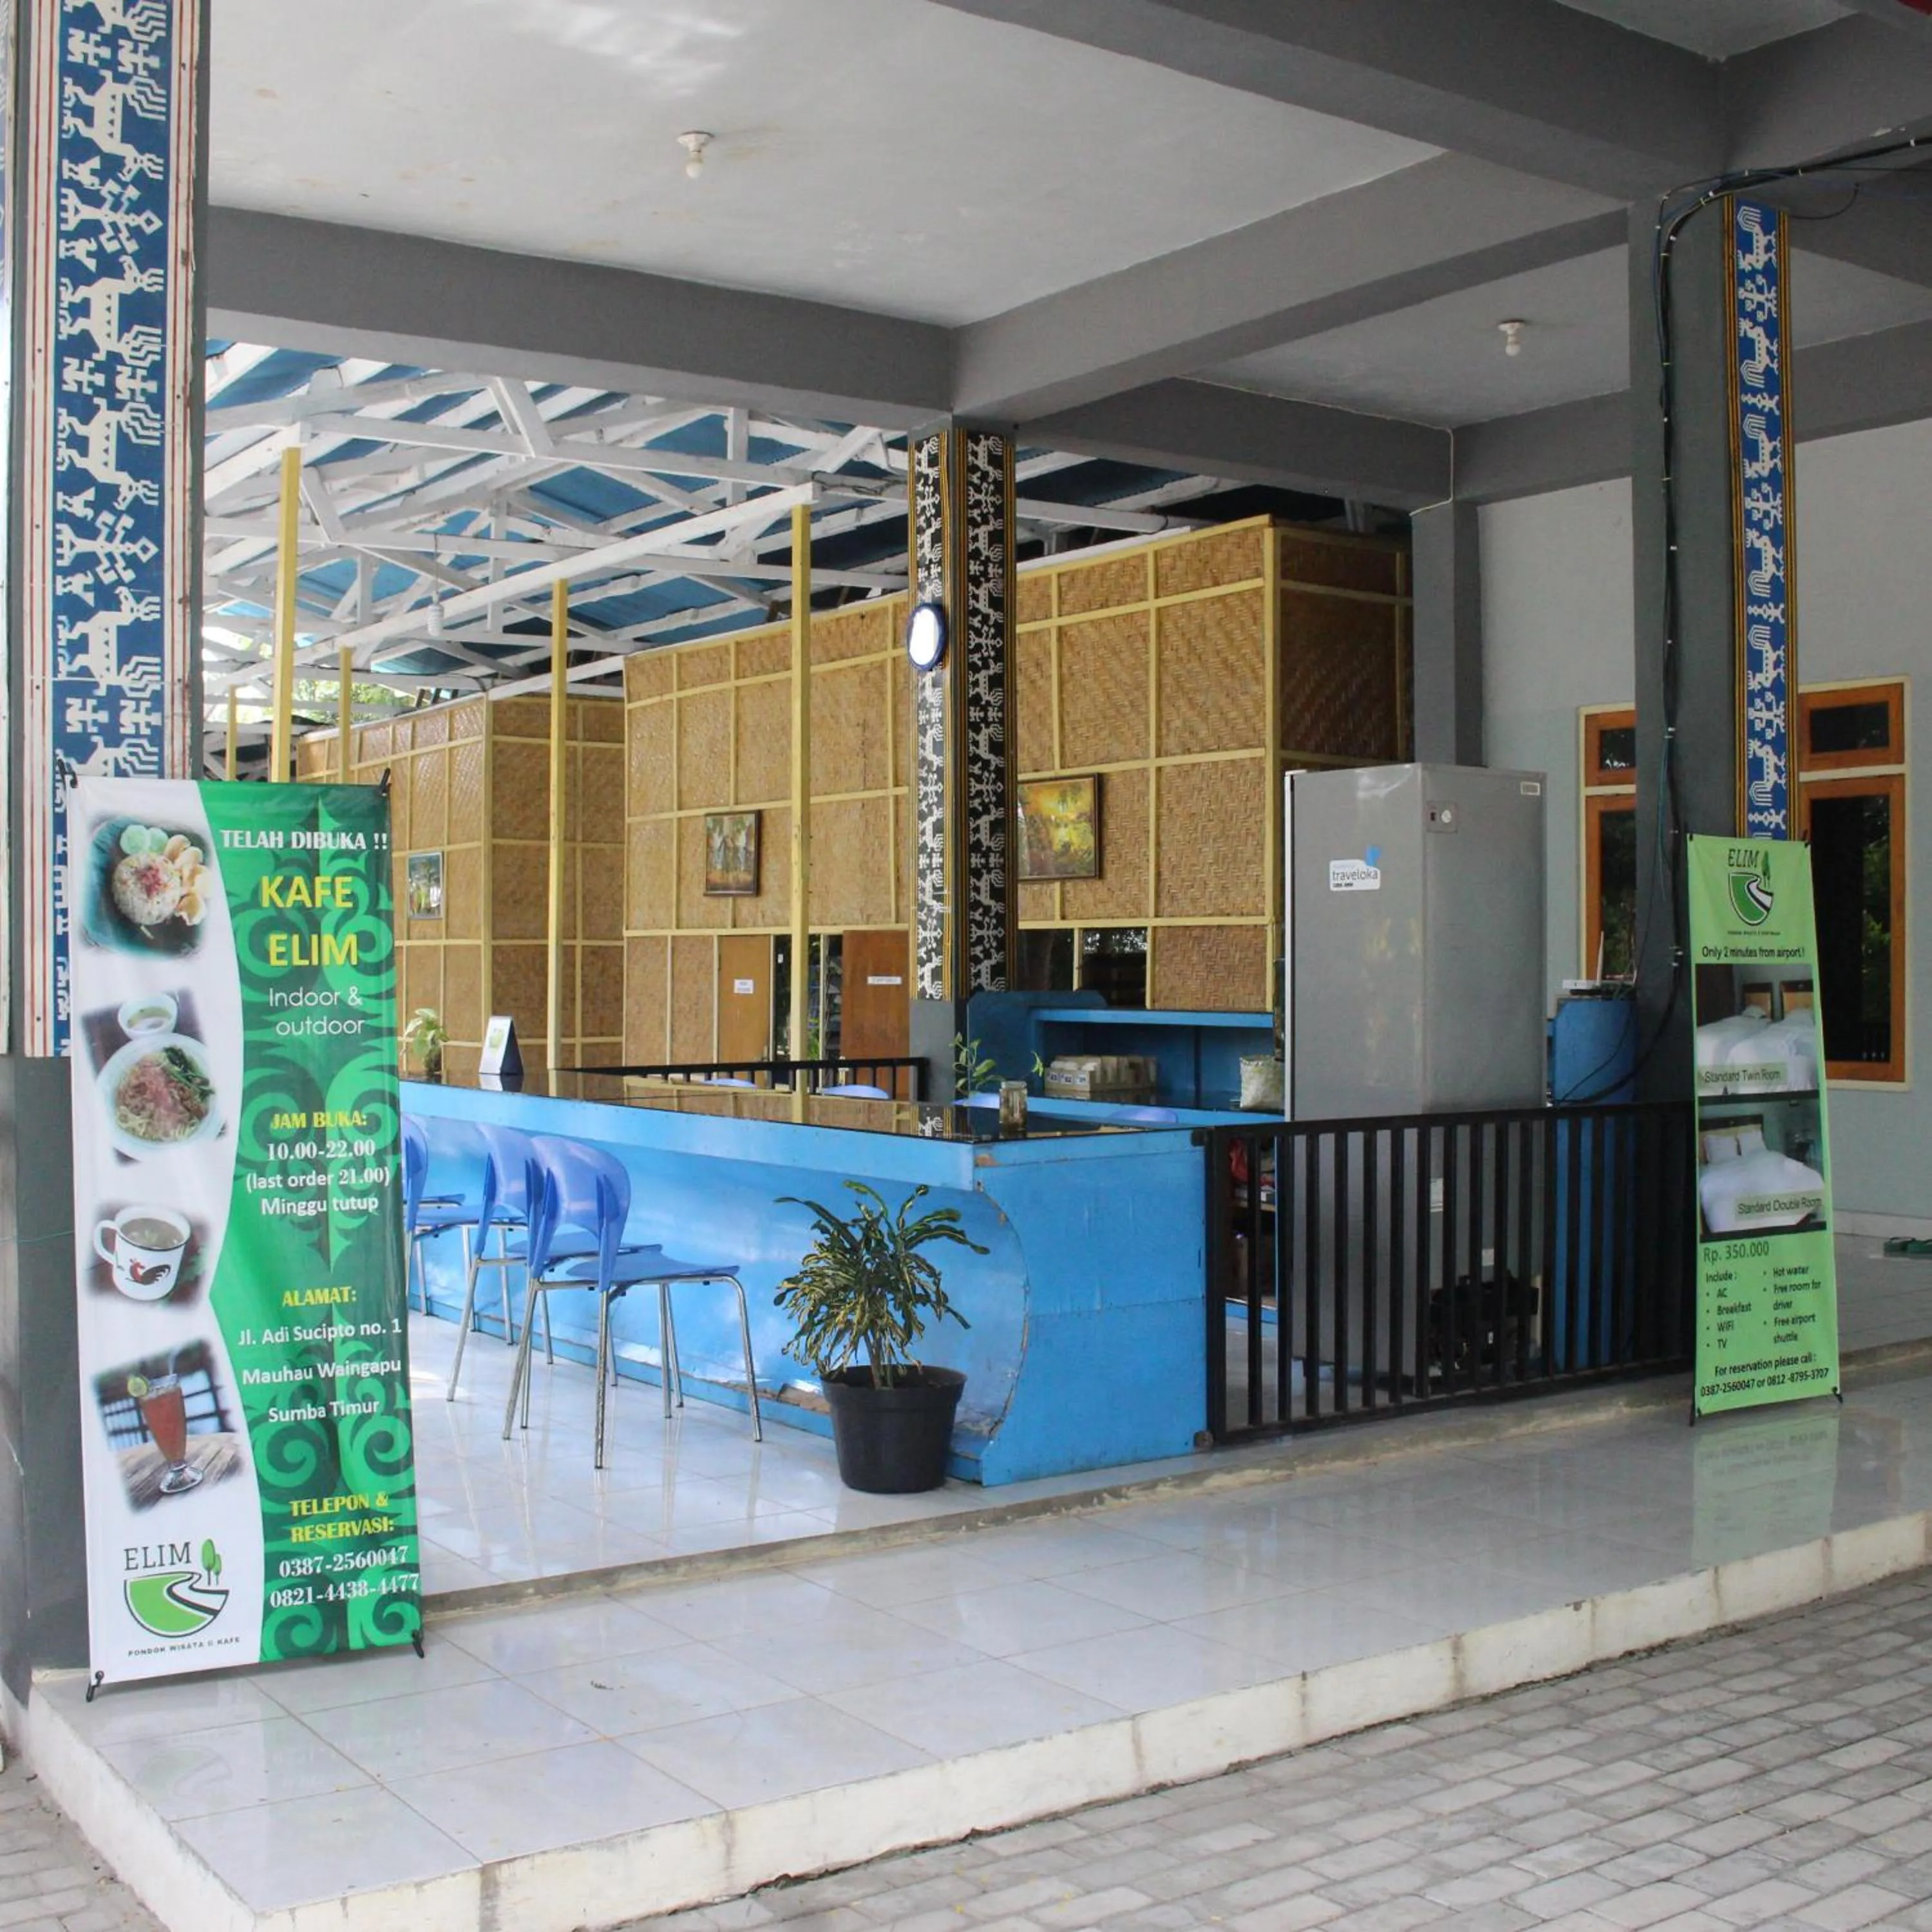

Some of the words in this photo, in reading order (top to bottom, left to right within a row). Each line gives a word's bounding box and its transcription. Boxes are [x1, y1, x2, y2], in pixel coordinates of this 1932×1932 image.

[220, 829, 283, 848] TELAH
[292, 831, 366, 849] DIBUKA
[1728, 848, 1760, 867] ELIM
[1332, 868, 1378, 880] traveloka
[261, 876, 354, 907] KAFE
[269, 934, 358, 966] ELIM
[1702, 946, 1722, 960] Only
[1724, 946, 1728, 958] 2
[1730, 947, 1757, 958] minutes
[1759, 947, 1776, 958] from
[269, 987, 340, 1007] Indoor
[348, 986, 363, 1006] &
[276, 1016, 365, 1036] outdoor
[1705, 1070, 1739, 1083] Standard
[1741, 1069, 1761, 1081] Twin
[1761, 1068, 1781, 1081] Room
[270, 1112, 306, 1129] JAM
[313, 1110, 367, 1128] BUKA:
[268, 1139, 375, 1160] 10.00-22.00
[246, 1173, 283, 1193] (last
[288, 1171, 333, 1188] order
[339, 1166, 390, 1186] 21.00)
[261, 1197, 327, 1216] Minggu
[332, 1197, 379, 1214] tutup
[1738, 1200, 1771, 1215] Standard
[1773, 1198, 1800, 1211] Double
[1801, 1197, 1822, 1208] Room
[1703, 1247, 1721, 1265] Rp.
[1725, 1241, 1769, 1260] 350.000
[1773, 1267, 1785, 1278] Hot
[1787, 1265, 1809, 1276] water
[282, 1285, 357, 1307] ALAMAT:
[1716, 1287, 1728, 1298] AC
[1774, 1283, 1788, 1294] Free
[1789, 1282, 1810, 1293] room
[1812, 1279, 1821, 1289] for
[1716, 1301, 1752, 1316] Breakfast
[1773, 1300, 1793, 1311] driver
[1774, 1316, 1789, 1327] Free
[1791, 1313, 1815, 1325] airport
[238, 1329, 256, 1345] Jl.
[261, 1327, 289, 1344] Adi
[293, 1323, 354, 1341] Sucipto
[360, 1321, 386, 1335] no.
[392, 1318, 402, 1333] 1
[1774, 1331, 1798, 1344] shuttle
[1718, 1338, 1727, 1349] TV
[242, 1366, 313, 1385] Mauhau
[316, 1359, 401, 1378] Waingapu
[1715, 1365, 1727, 1377] For
[1729, 1358, 1772, 1374] reservation
[1774, 1355, 1799, 1370] please
[1700, 1378, 1756, 1397] 0387-2560047
[1756, 1379, 1765, 1388] or
[268, 1403, 326, 1422] Sumba
[330, 1400, 379, 1416] Timur
[289, 1493, 369, 1517] TELEPON
[376, 1491, 388, 1507] &
[291, 1515, 395, 1543] RESERVASI:
[124, 1542, 192, 1571] ELIM
[279, 1546, 408, 1578] 0387-2560047
[270, 1573, 420, 1608] 0821-4438-4477
[169, 1641, 205, 1653] WISATA
[218, 1636, 240, 1645] KAFE
